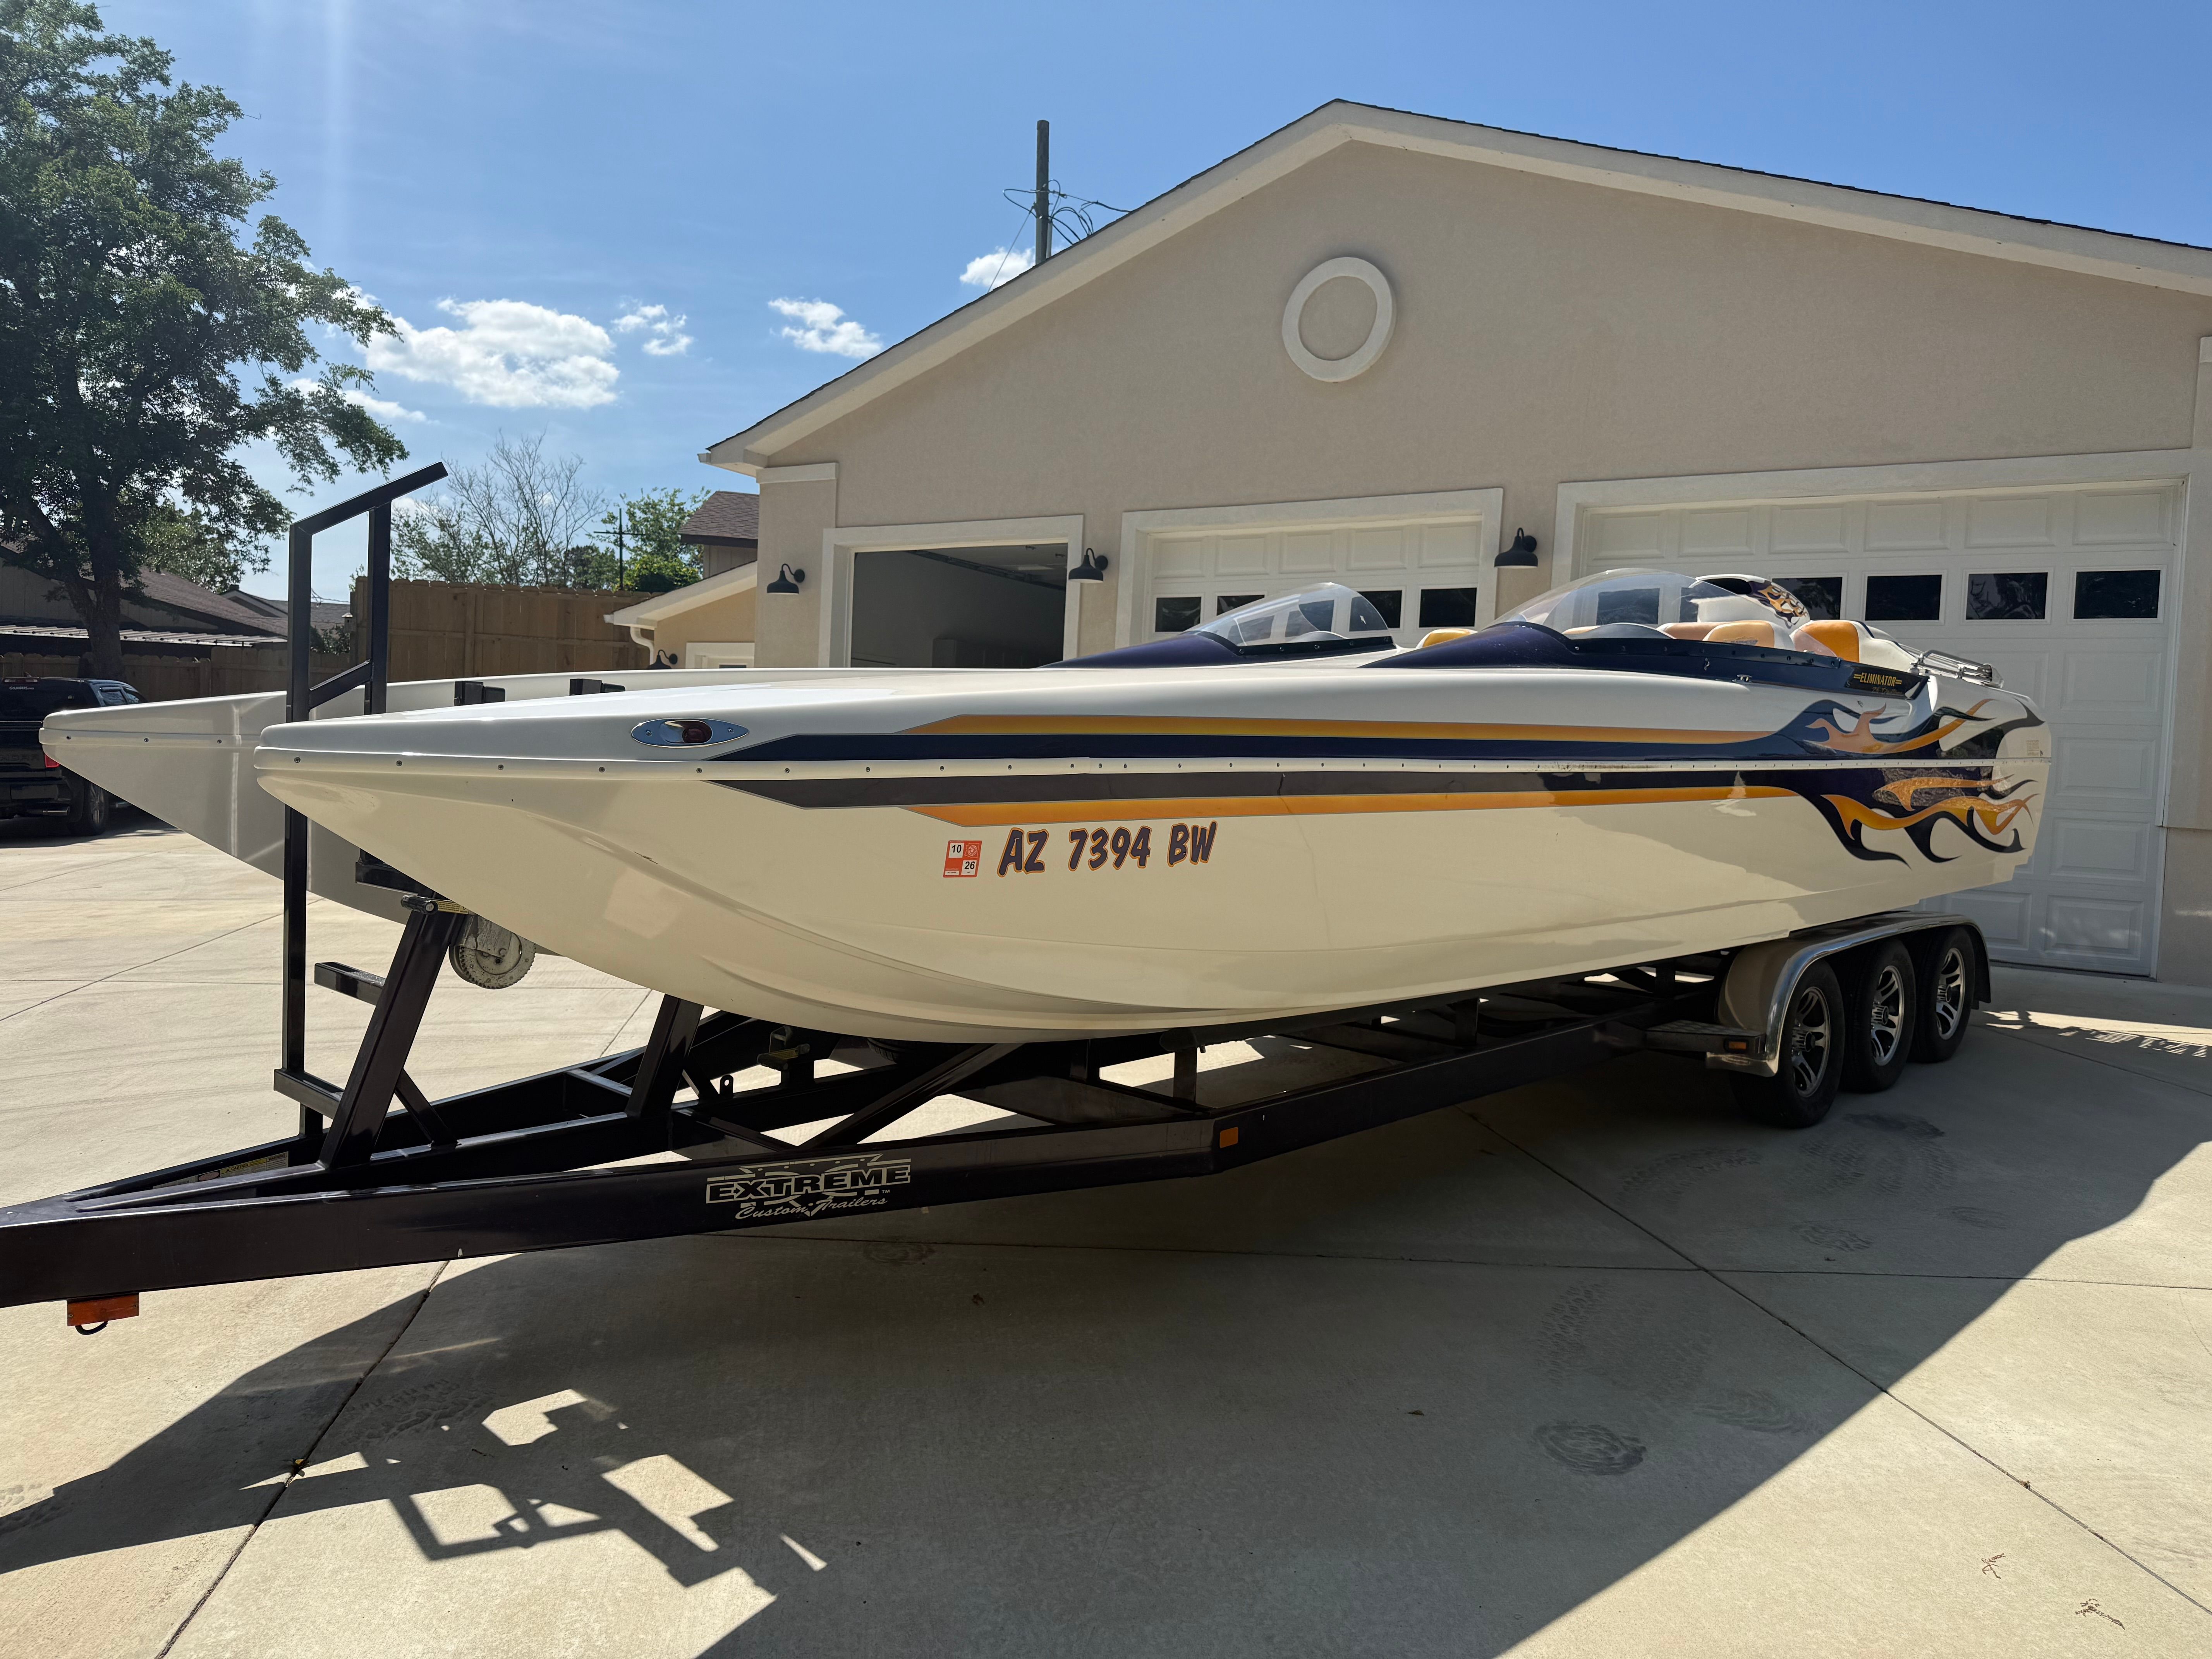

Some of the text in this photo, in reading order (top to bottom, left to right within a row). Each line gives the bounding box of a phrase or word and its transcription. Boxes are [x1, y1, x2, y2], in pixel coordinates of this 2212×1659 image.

[1860, 672, 1896, 687] ELIMINATOR
[951, 845, 962, 853] 10
[997, 820, 1218, 878] AZ 7394 BW
[964, 861, 975, 869] 26
[706, 1164, 911, 1204] EXTREME
[735, 1196, 888, 1219] Custom Trailers
